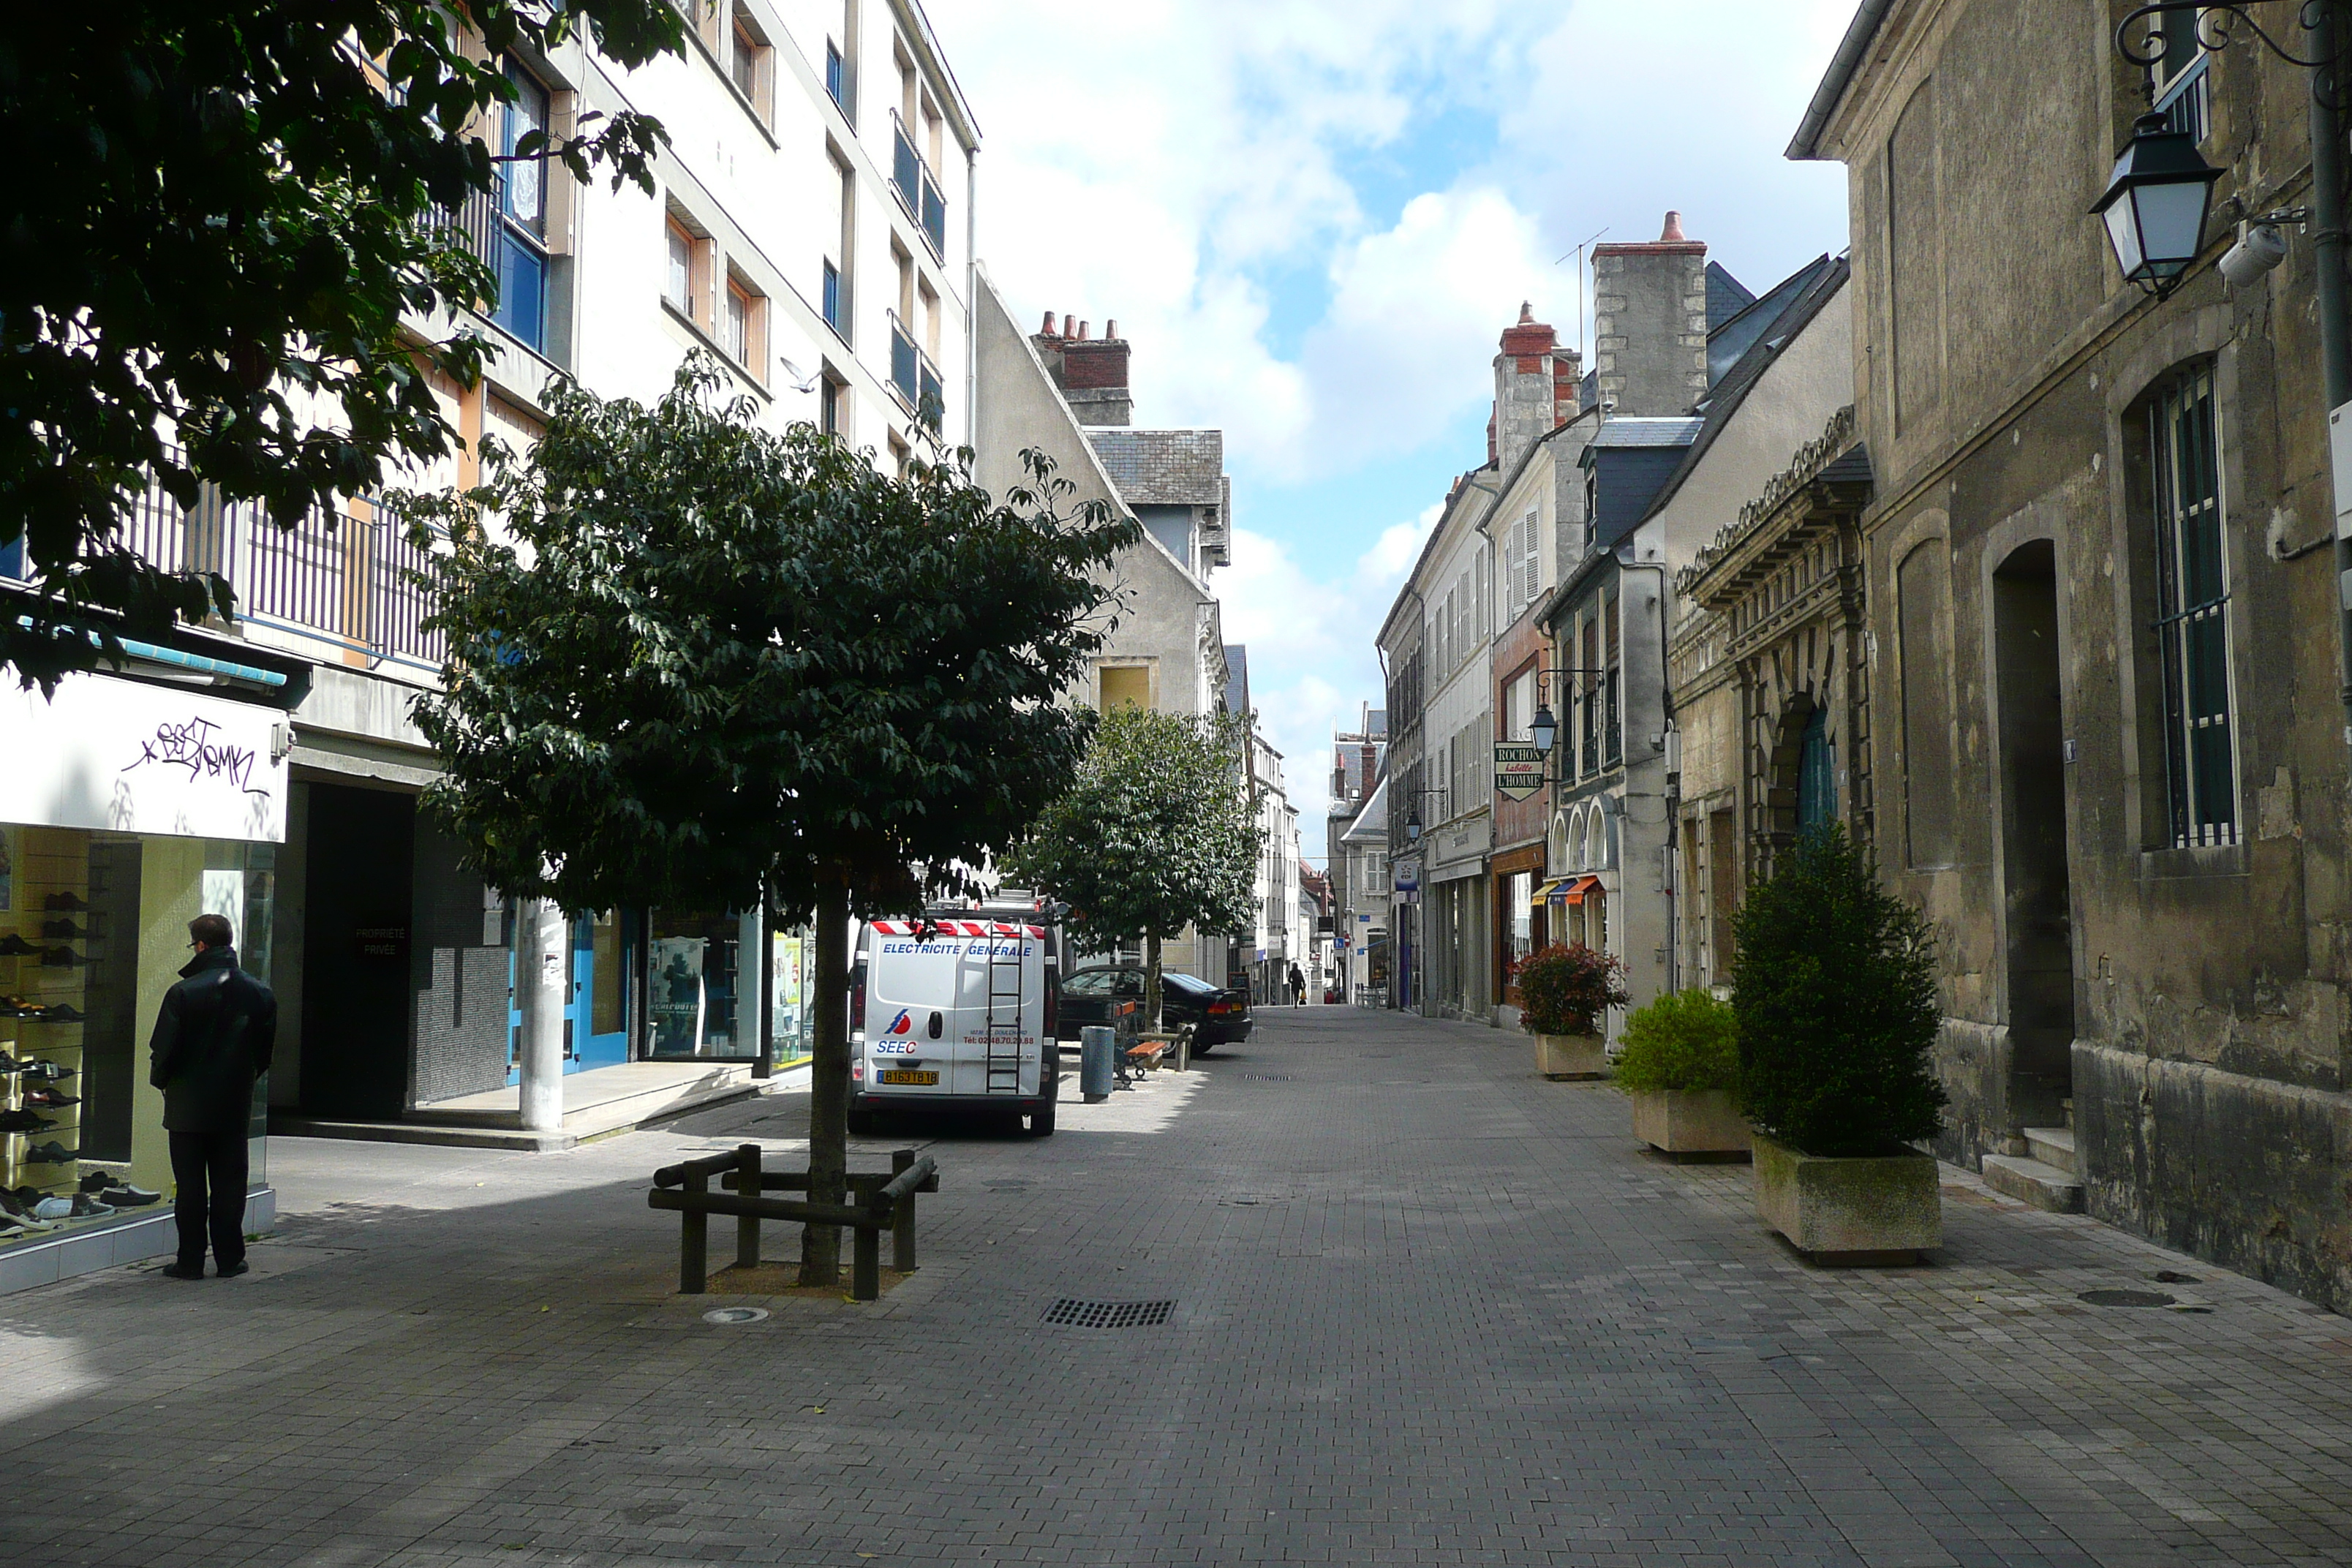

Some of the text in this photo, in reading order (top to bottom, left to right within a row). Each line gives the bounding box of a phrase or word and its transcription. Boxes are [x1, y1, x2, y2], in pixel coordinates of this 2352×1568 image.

[1499, 749, 1540, 761] ROCHON
[1505, 763, 1533, 772] habille
[1498, 774, 1541, 787] L'HOMME
[355, 927, 405, 938] PROPRIÉTÉ
[364, 943, 396, 955] PRIVÉE
[883, 943, 962, 954] ELECTRICITE
[963, 1036, 1034, 1045] Tél: 0248.70.2.88
[877, 1041, 917, 1054] SEEC
[926, 1072, 938, 1083] 18
